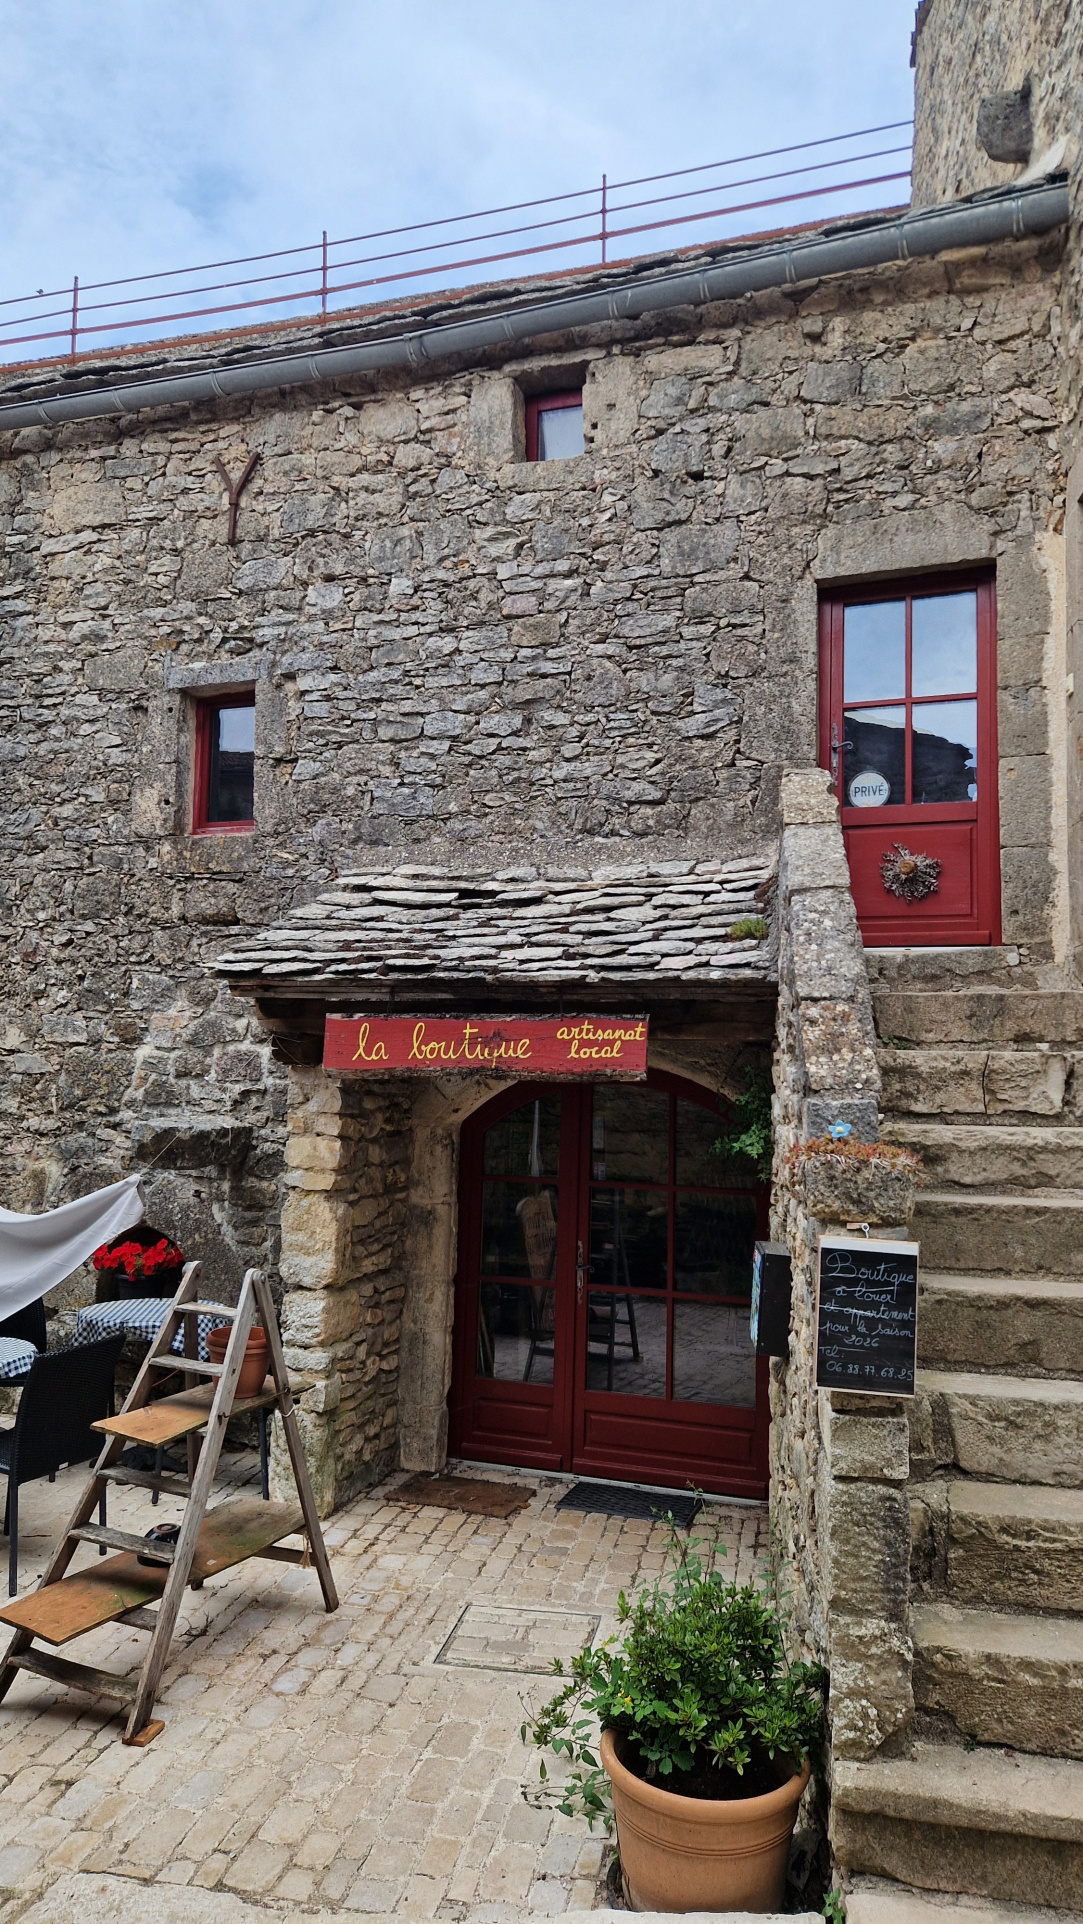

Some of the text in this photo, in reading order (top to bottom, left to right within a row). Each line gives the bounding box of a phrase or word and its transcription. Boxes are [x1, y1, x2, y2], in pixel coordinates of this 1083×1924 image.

[854, 782, 885, 797] PRIVÉ
[556, 1020, 646, 1041] artisanat
[352, 1022, 532, 1068] la boutique
[567, 1037, 624, 1059] local
[826, 1252, 915, 1300] Boutique
[854, 1281, 896, 1304] louer
[824, 1299, 840, 1312] et
[820, 1320, 914, 1338] pour la saison
[844, 1334, 879, 1347] 2026
